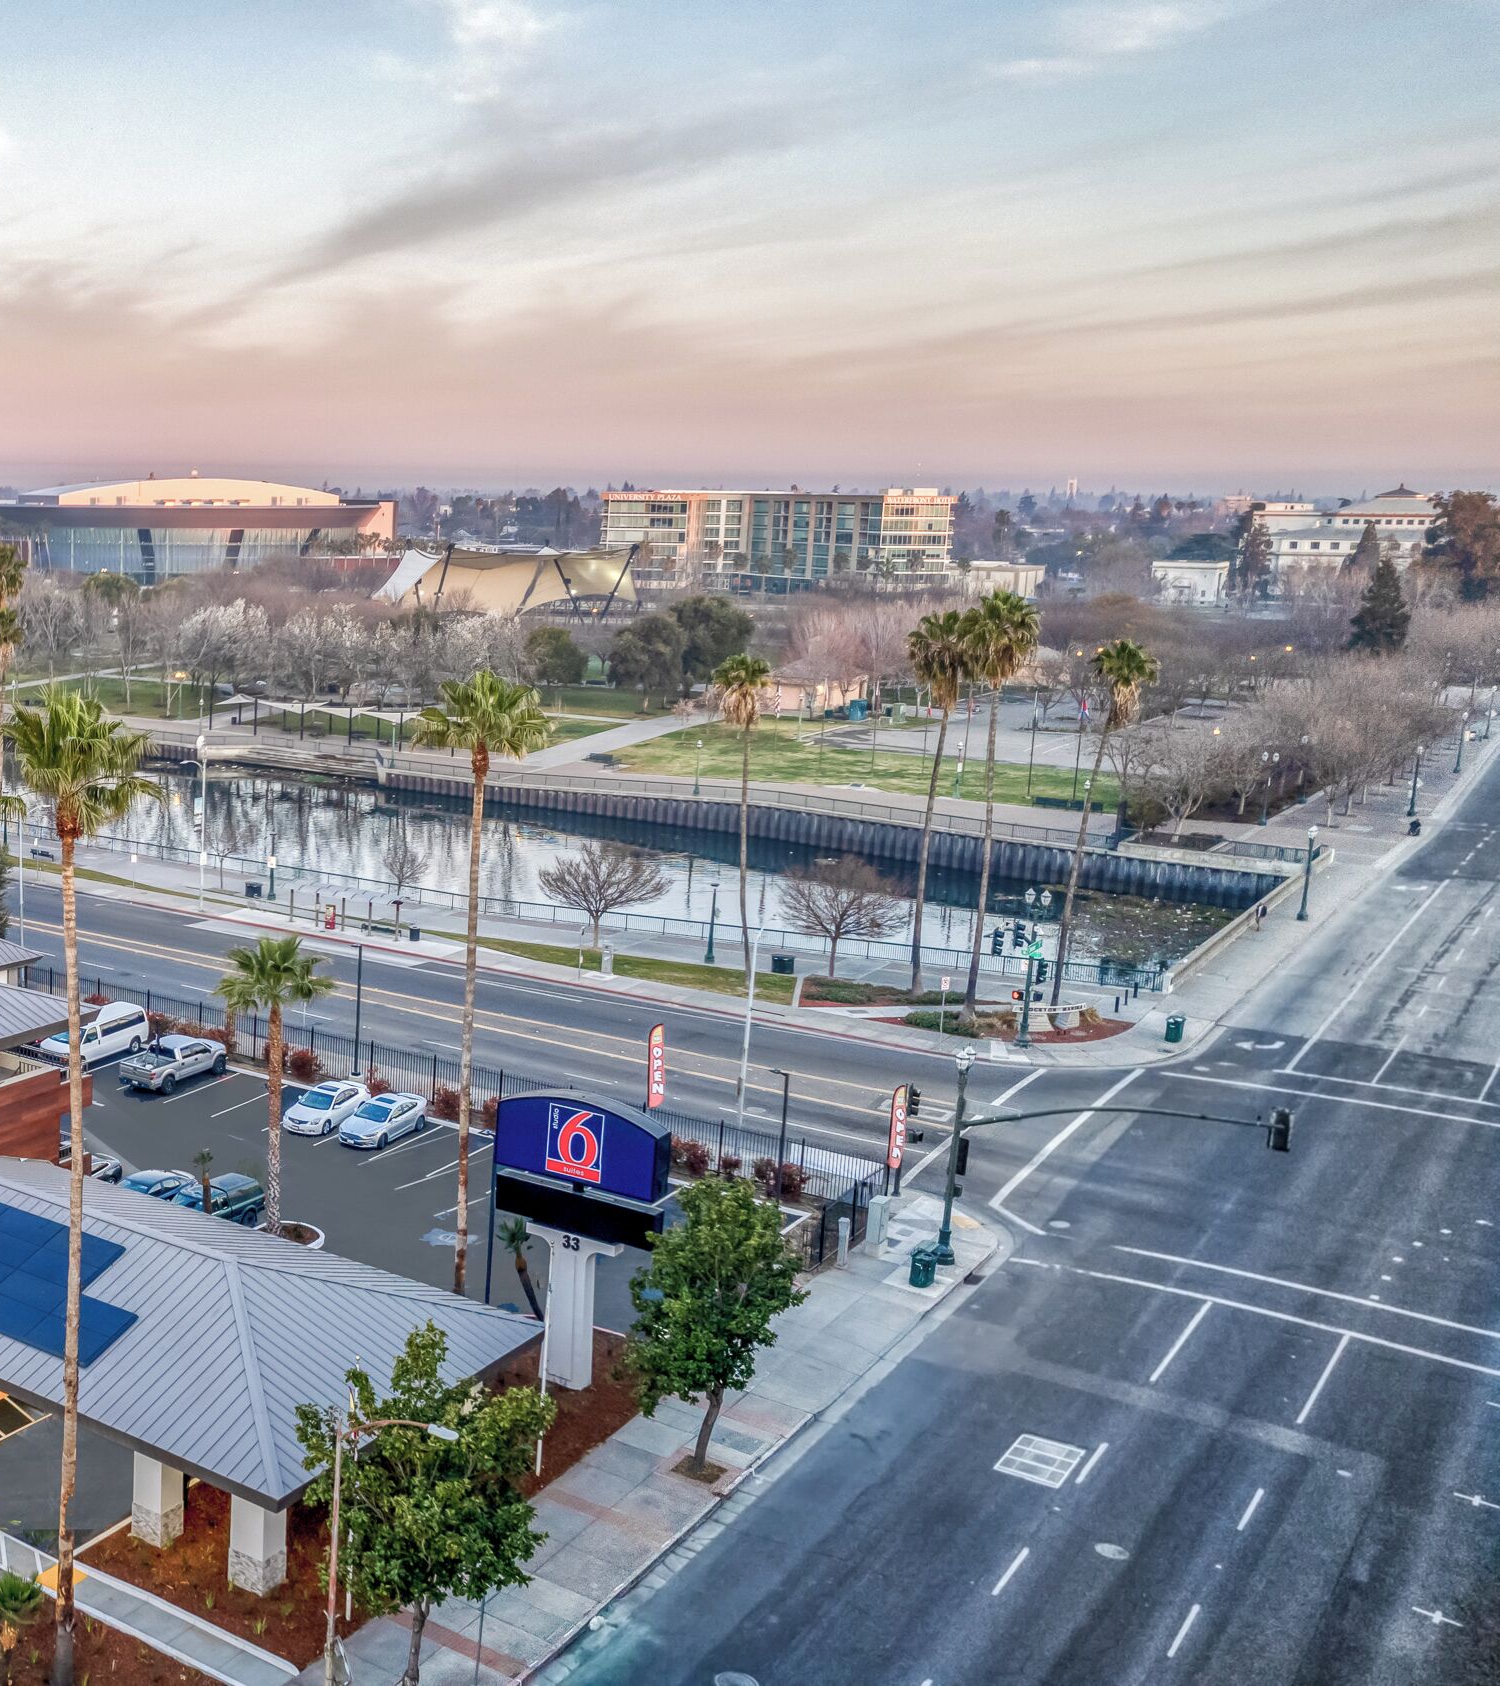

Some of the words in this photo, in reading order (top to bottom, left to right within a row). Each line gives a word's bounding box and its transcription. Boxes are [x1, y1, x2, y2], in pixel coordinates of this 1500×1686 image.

[651, 1046, 663, 1094] OPEN
[557, 1110, 598, 1169] 6
[563, 1166, 585, 1176] suites
[562, 1234, 580, 1251] 33
